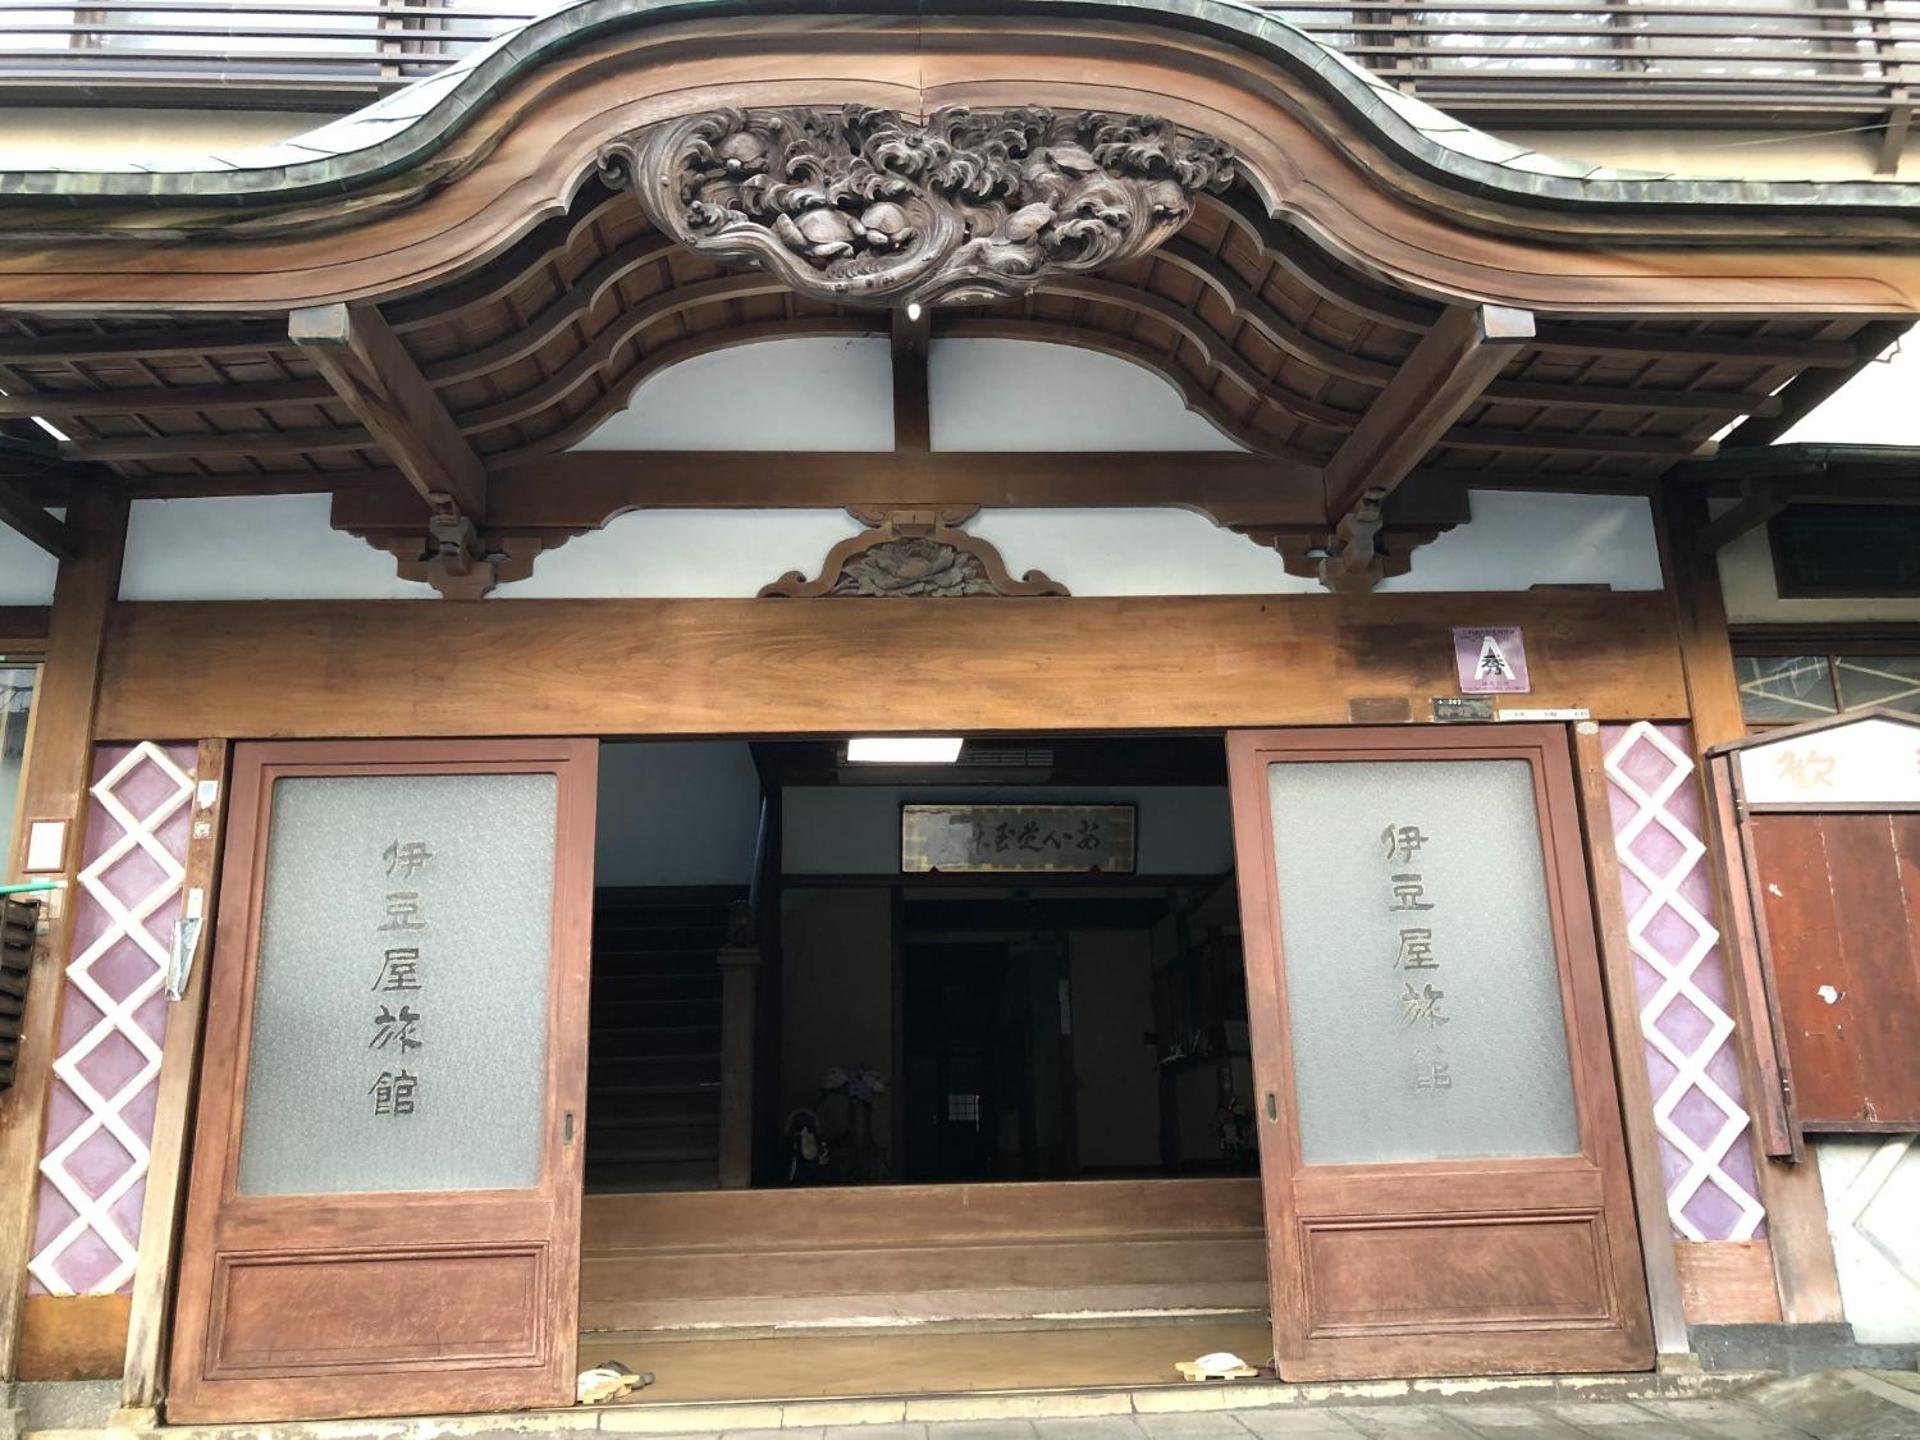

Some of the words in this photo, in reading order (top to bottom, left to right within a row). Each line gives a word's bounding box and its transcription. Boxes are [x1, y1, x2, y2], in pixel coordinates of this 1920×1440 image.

[1474, 636, 1516, 680] A
[1481, 653, 1505, 675] 秀
[368, 838, 433, 1117] 伊豆屋旅館
